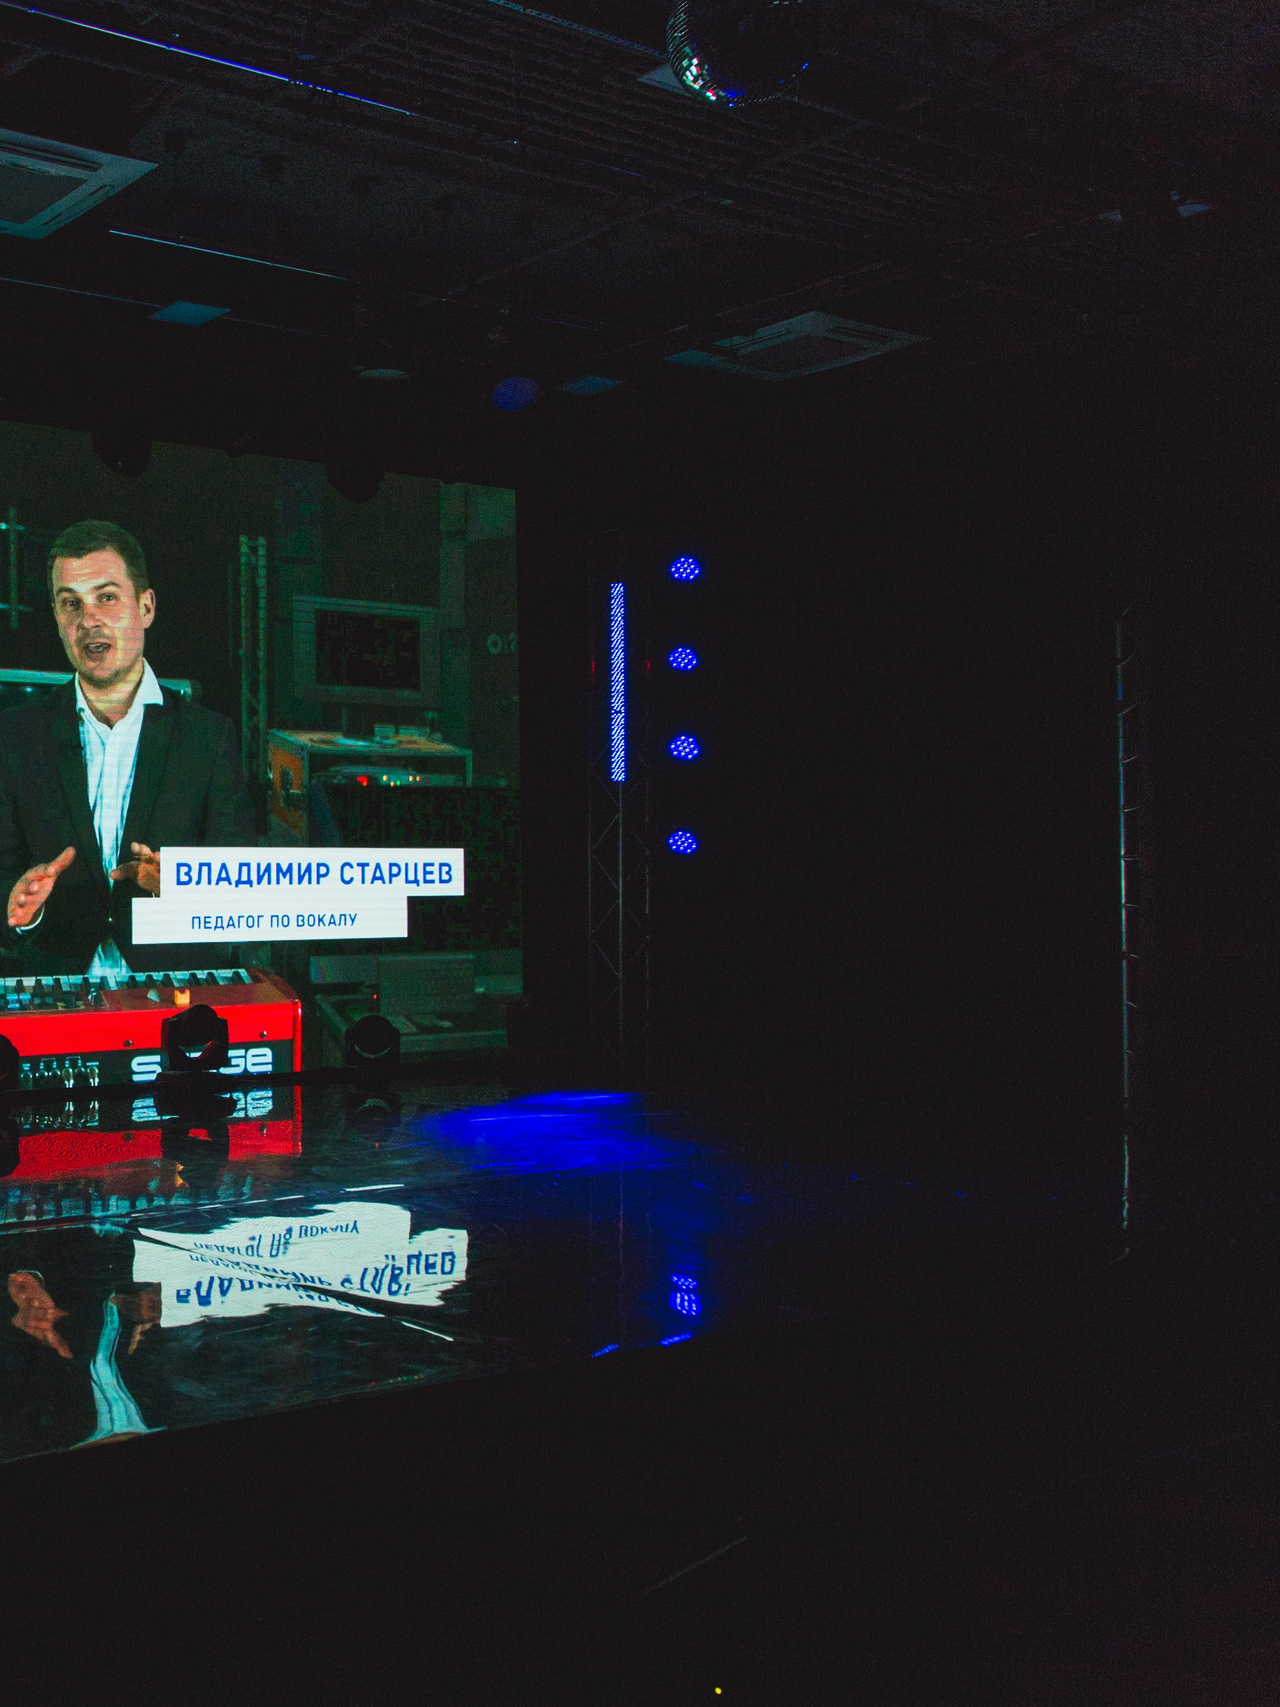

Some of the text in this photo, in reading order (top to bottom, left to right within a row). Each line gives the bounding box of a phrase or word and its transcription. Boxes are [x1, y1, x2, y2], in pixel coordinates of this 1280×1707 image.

[175, 861, 454, 889] ВЛАДИМИР СТАРЦЕВ
[191, 913, 358, 932] ПЕДАГОГ ПО ВОКАЛУ
